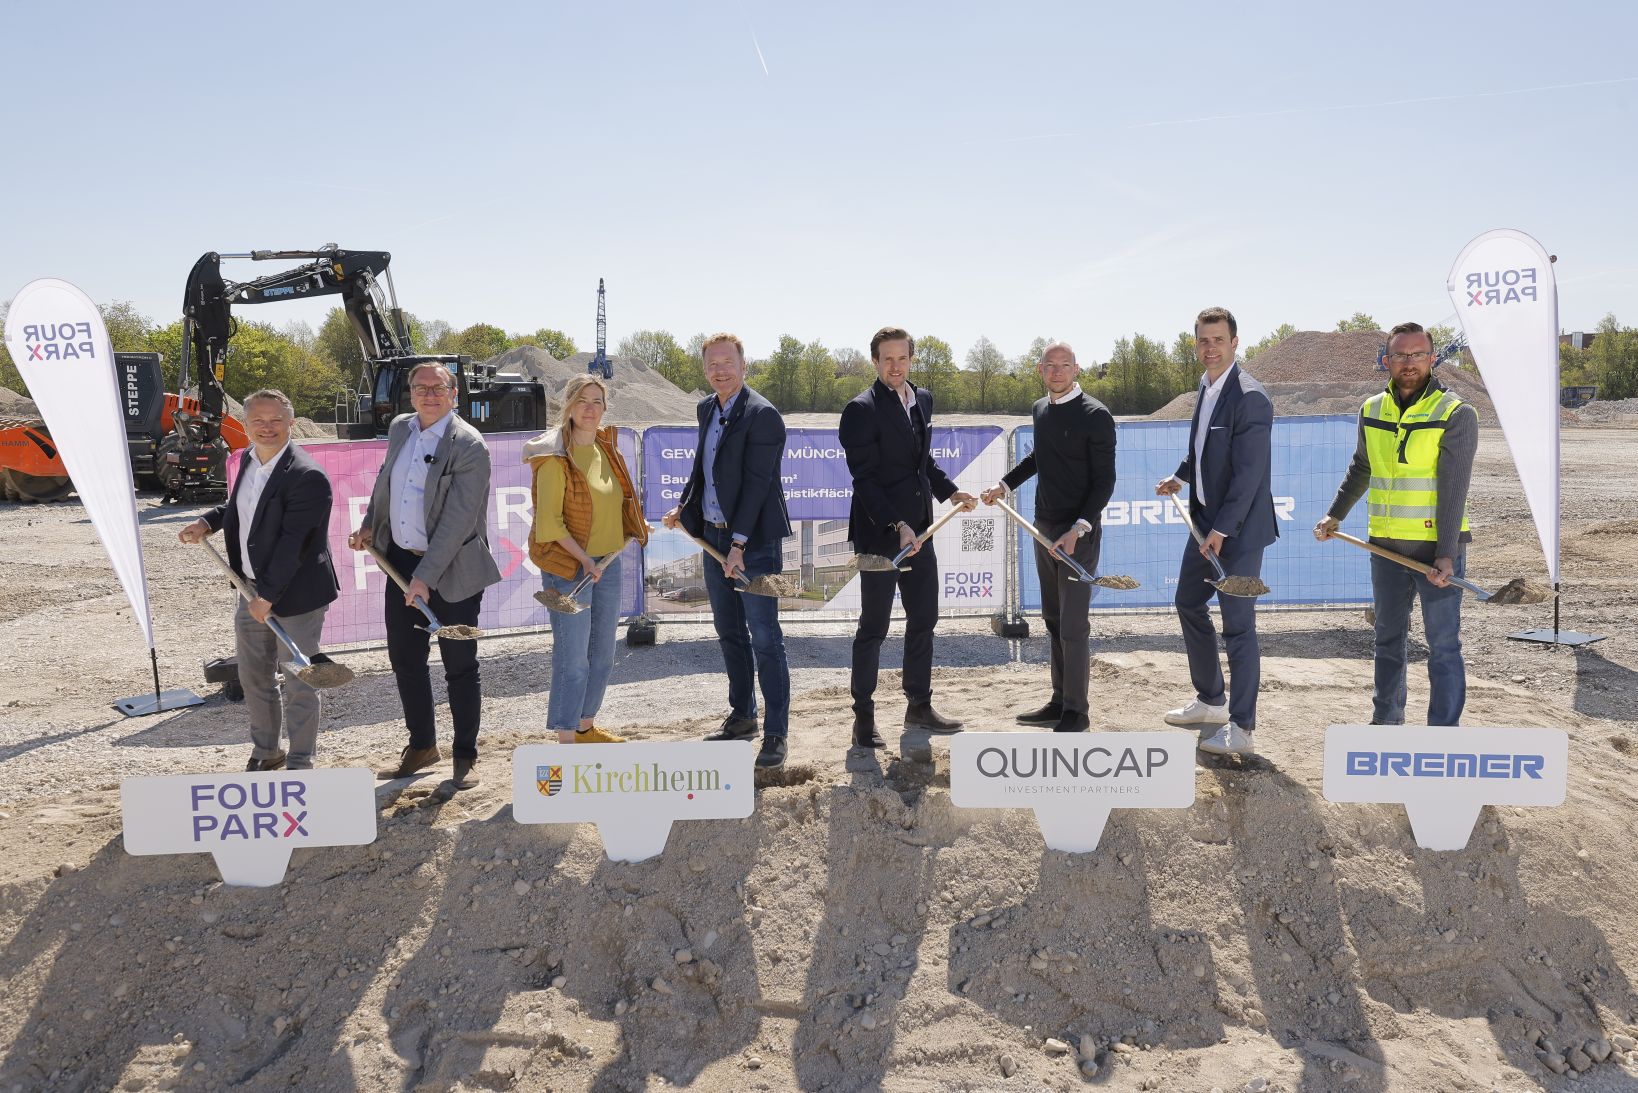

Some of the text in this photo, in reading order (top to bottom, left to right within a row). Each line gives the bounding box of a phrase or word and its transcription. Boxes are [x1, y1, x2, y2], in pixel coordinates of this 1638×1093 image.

[127, 365, 140, 416] STEPPE
[783, 488, 854, 501] gistikfläch
[349, 486, 533, 534] FR
[1101, 496, 1296, 526] BRER
[944, 572, 993, 584] FOUR
[944, 585, 993, 598] PARX
[976, 747, 1169, 778] QUINCAP
[1346, 751, 1545, 780] BREMER
[191, 781, 306, 811] FOUR
[1004, 785, 1140, 794] INVESTMENT PARTNERS
[193, 810, 309, 842] PARX
